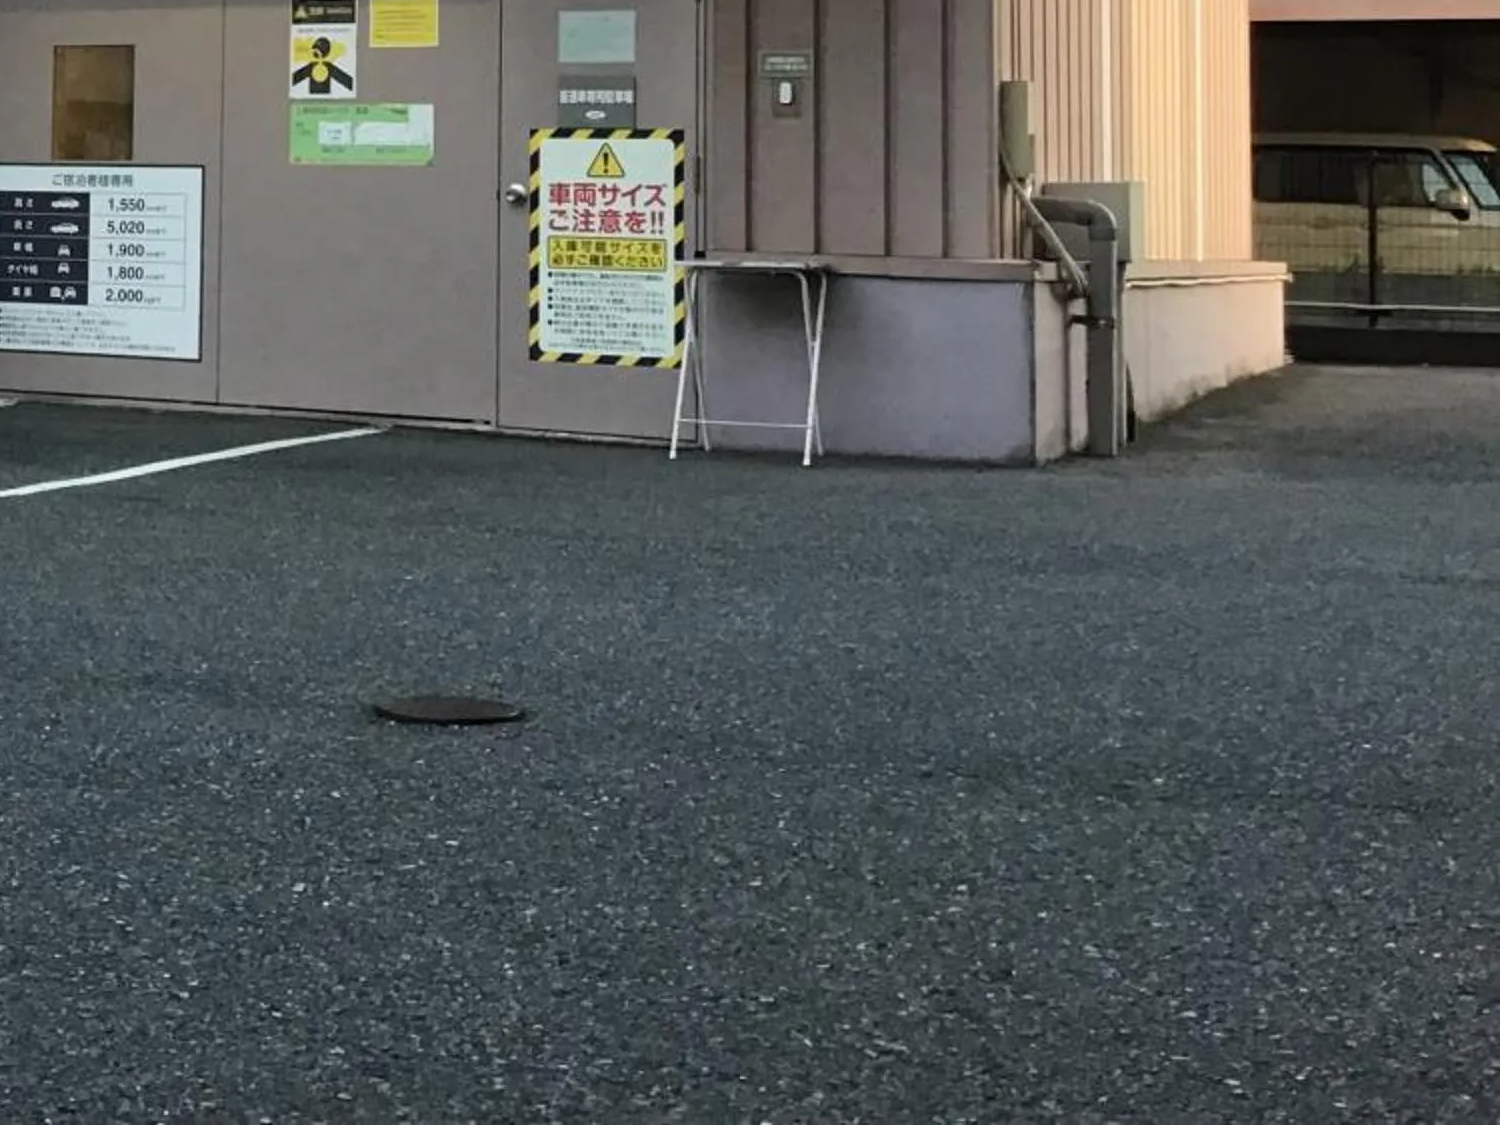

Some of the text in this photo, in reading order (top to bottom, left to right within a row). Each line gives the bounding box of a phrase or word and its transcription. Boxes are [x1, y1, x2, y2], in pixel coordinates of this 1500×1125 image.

[548, 182, 668, 207] 車両サイズ
[108, 197, 145, 213] 1,550
[106, 220, 145, 235] 5,020
[108, 243, 145, 258] 1,900
[551, 254, 664, 268] 必ずご確認ください
[107, 266, 145, 280] 1,800
